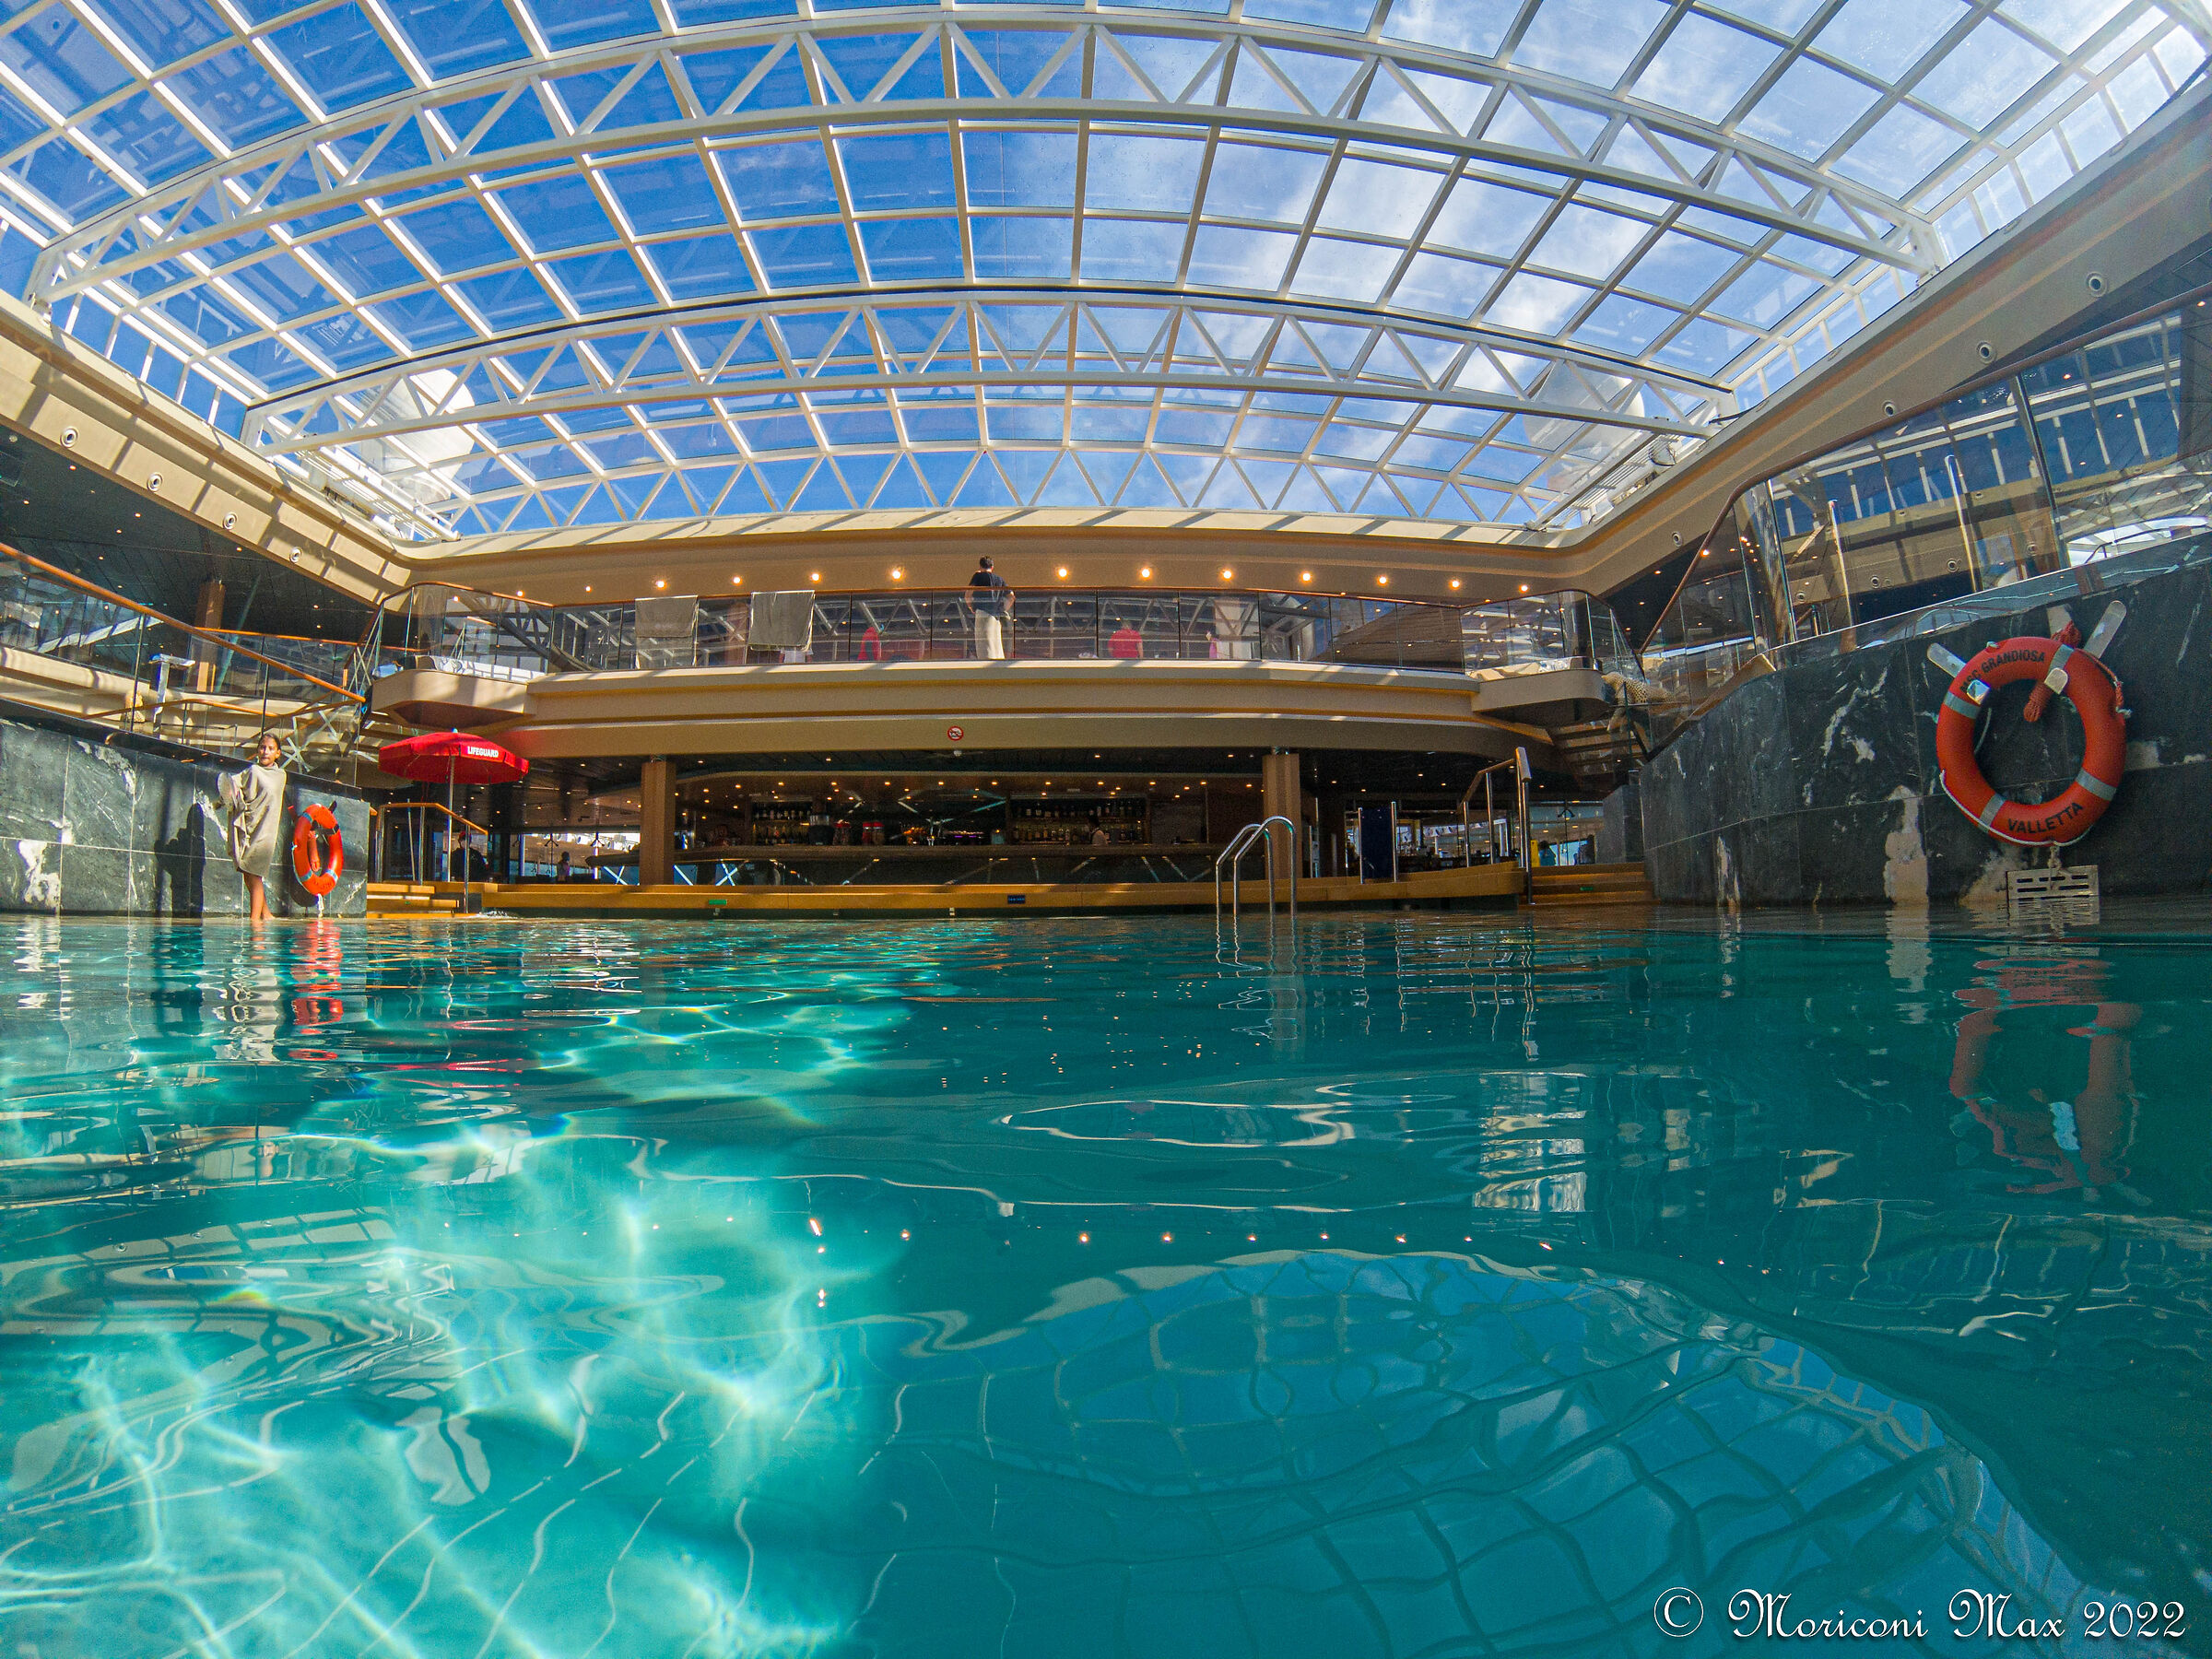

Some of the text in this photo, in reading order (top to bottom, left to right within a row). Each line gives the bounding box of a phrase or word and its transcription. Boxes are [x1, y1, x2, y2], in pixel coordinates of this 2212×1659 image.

[1981, 649, 2045, 673] GRANDIOSA
[467, 746, 499, 758] LIFEGUARD
[2007, 802, 2083, 833] VALLETTA
